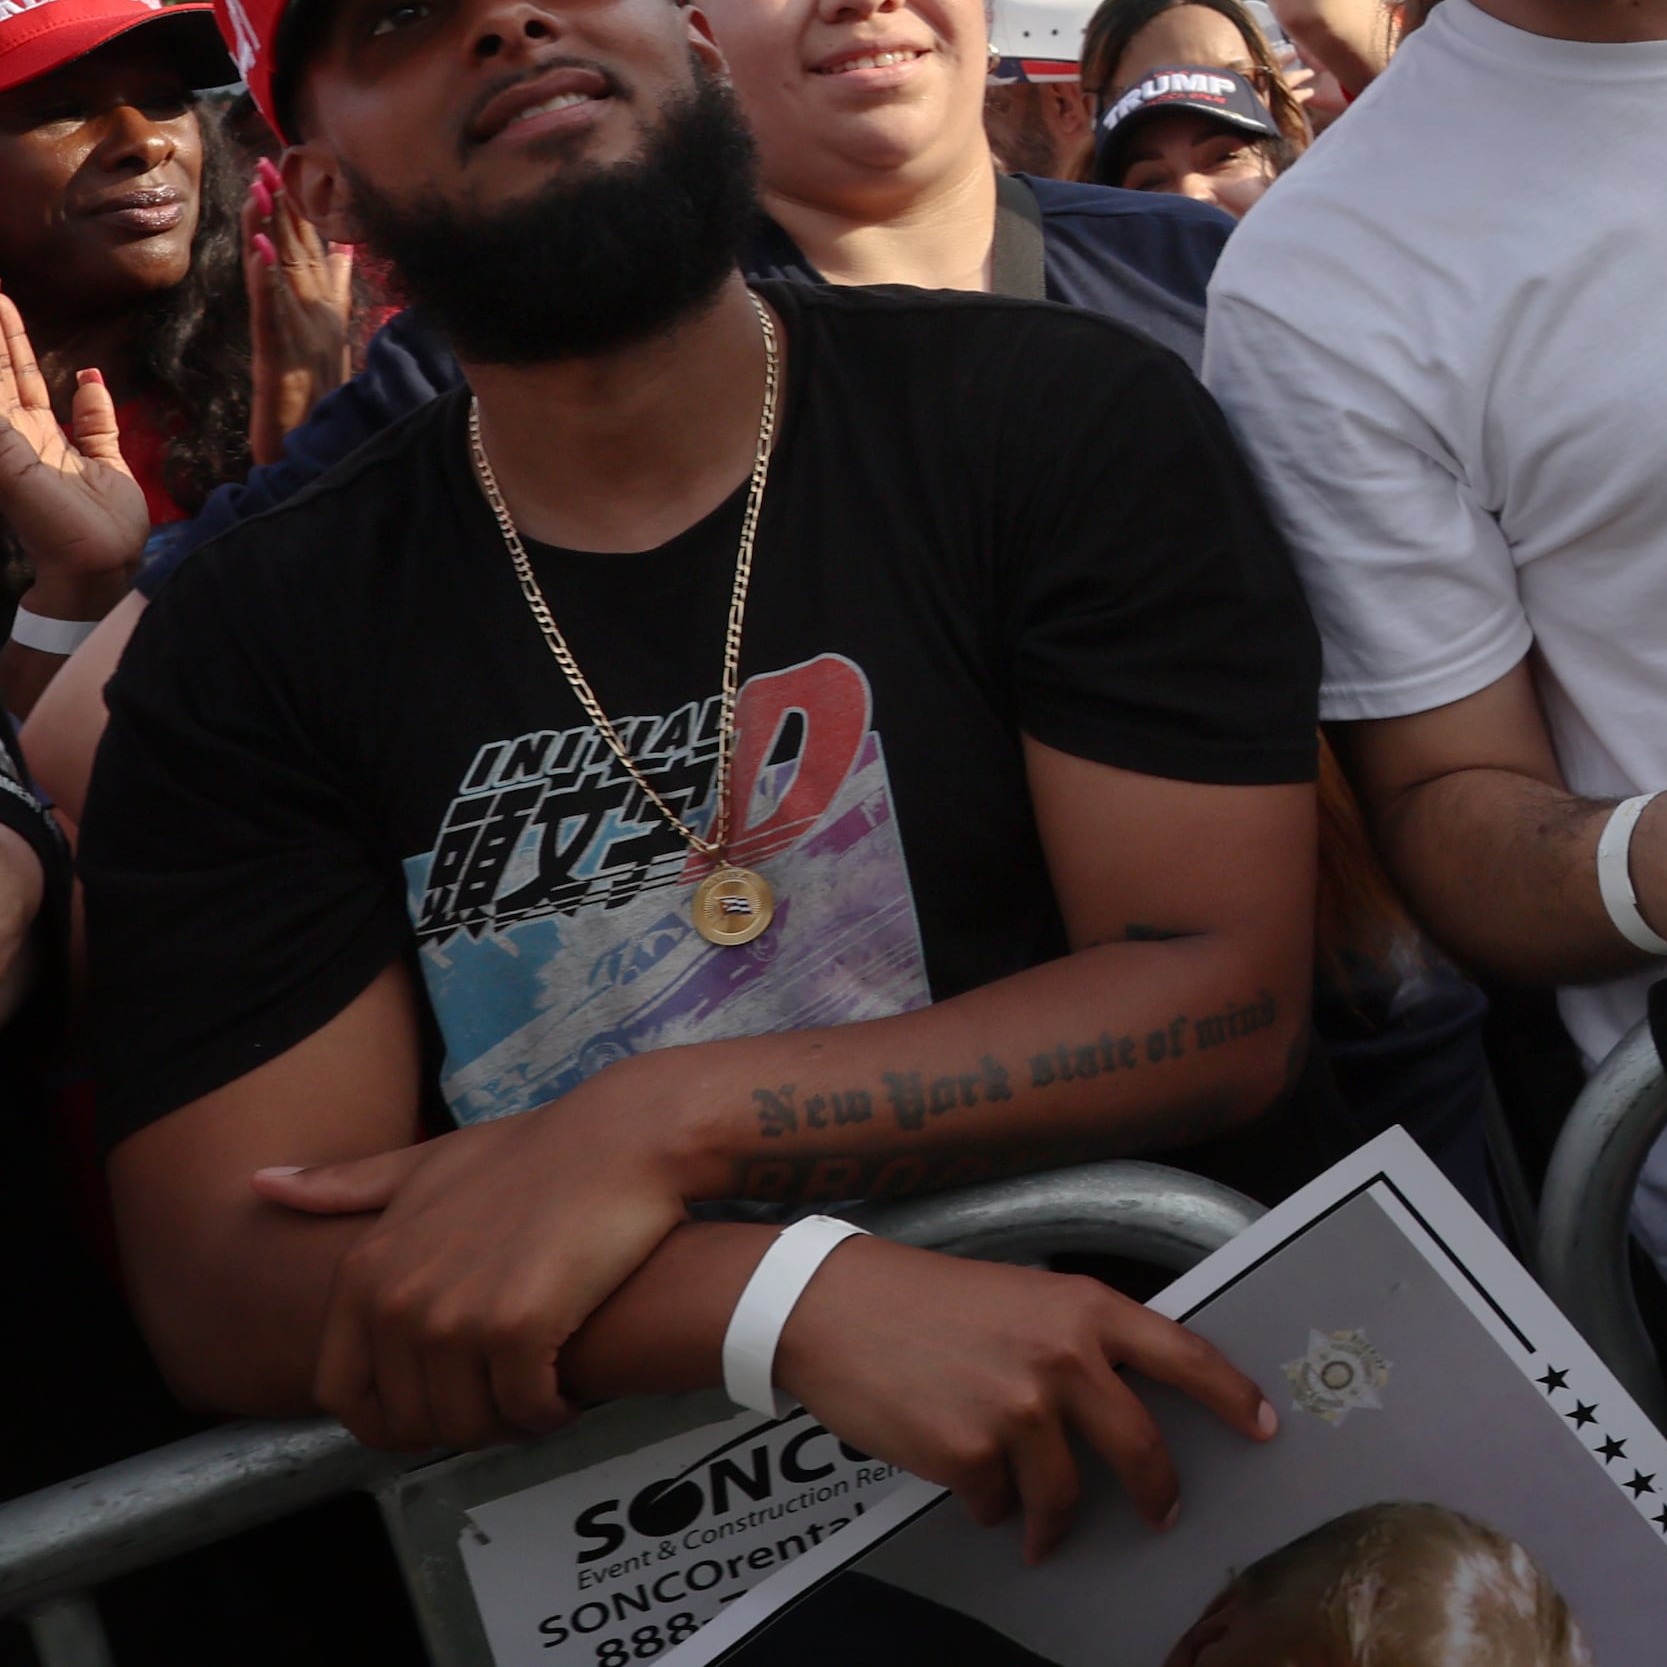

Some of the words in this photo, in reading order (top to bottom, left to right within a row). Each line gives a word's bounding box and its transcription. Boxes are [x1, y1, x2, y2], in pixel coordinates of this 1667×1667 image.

[1103, 73, 1236, 130] TRUMP
[459, 694, 738, 794] INITIAL
[677, 652, 872, 887] D
[753, 1084, 872, 1136] New
[884, 1054, 1013, 1131] York
[1027, 1034, 1138, 1089] state
[1145, 1014, 1194, 1064] of
[1196, 988, 1277, 1051] mind
[577, 1550, 652, 1591] Event
[656, 1539, 678, 1562] &
[682, 1478, 850, 1551] Construction
